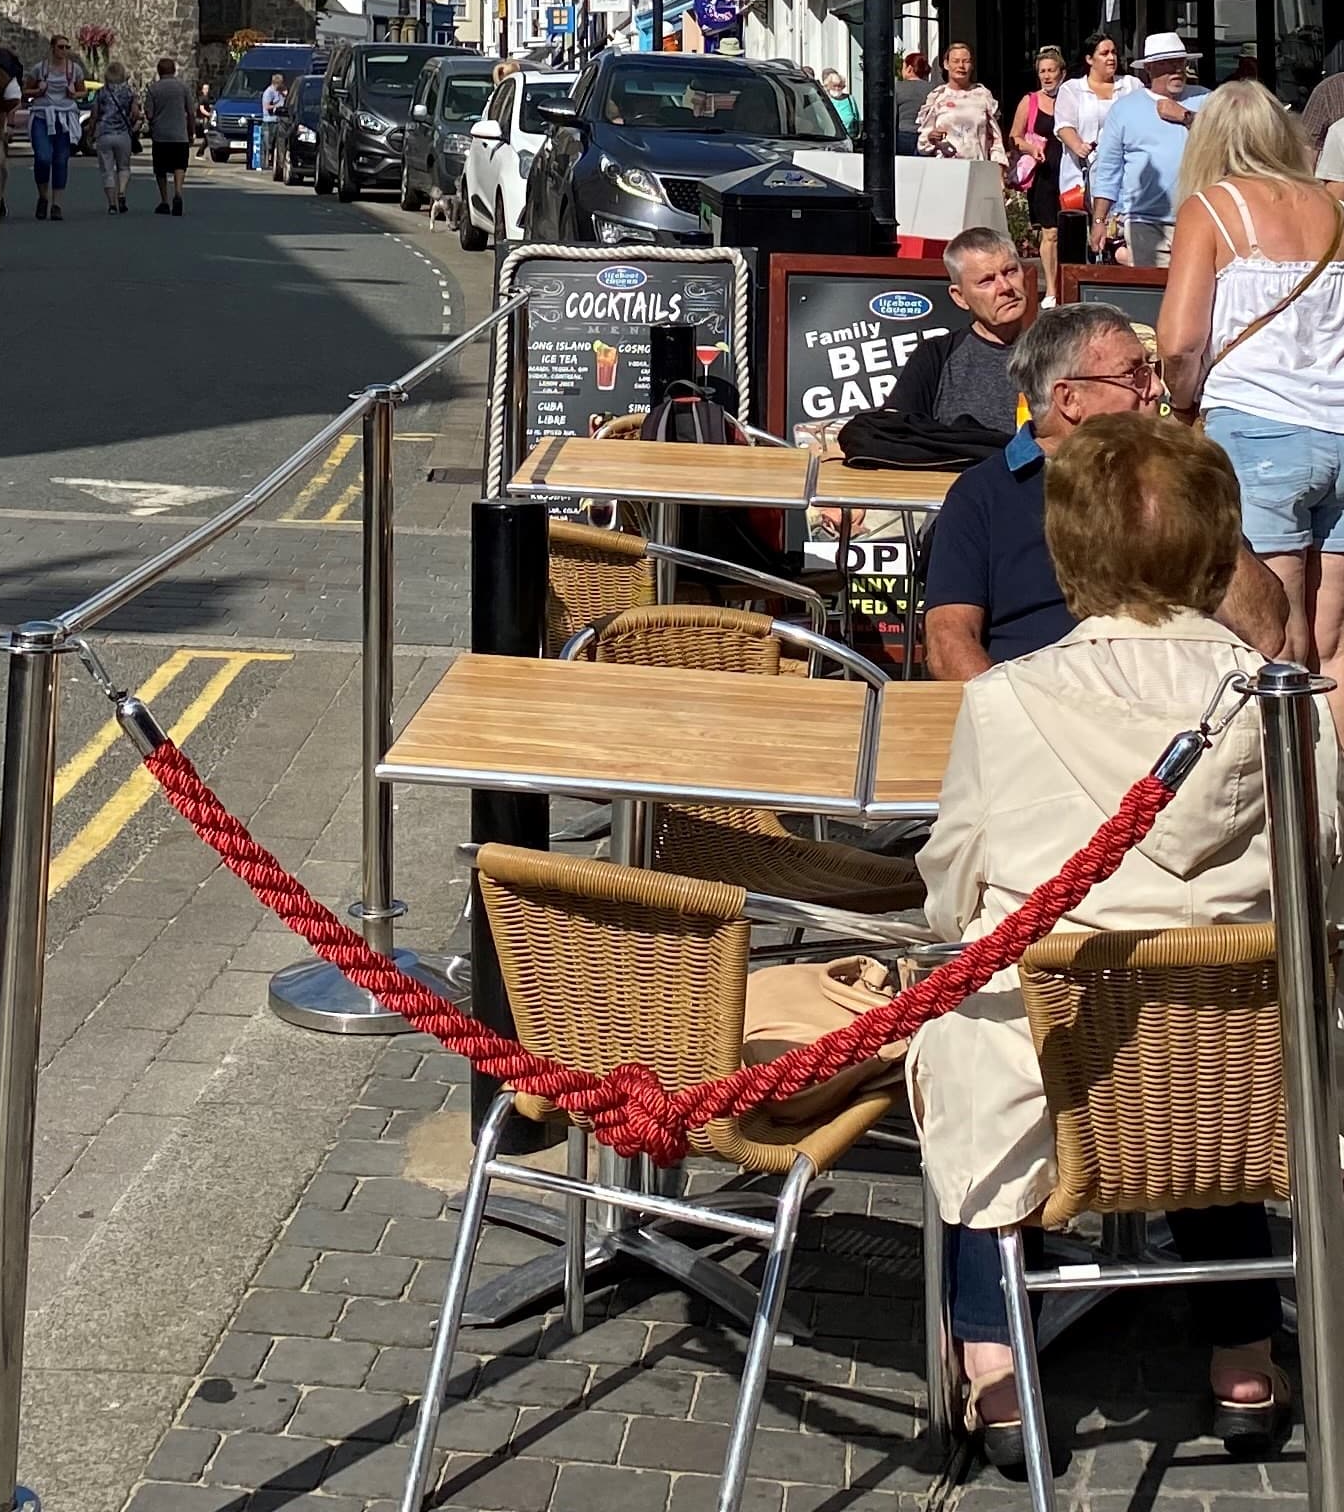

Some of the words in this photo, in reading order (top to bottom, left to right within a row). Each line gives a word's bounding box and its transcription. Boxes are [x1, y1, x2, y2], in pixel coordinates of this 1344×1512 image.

[565, 290, 682, 324] COCKTAILS
[878, 298, 923, 308] lifeboat
[880, 306, 923, 315] tavern
[587, 325, 649, 336] MEN
[805, 320, 881, 348] Family
[555, 342, 592, 352] ISLAND
[541, 355, 558, 365] ICE
[559, 355, 578, 365] TEA
[802, 374, 899, 419] GAR
[537, 402, 564, 413] CUBA
[537, 415, 567, 426] LIBRE
[835, 545, 899, 573] OP
[851, 578, 897, 594] NNY
